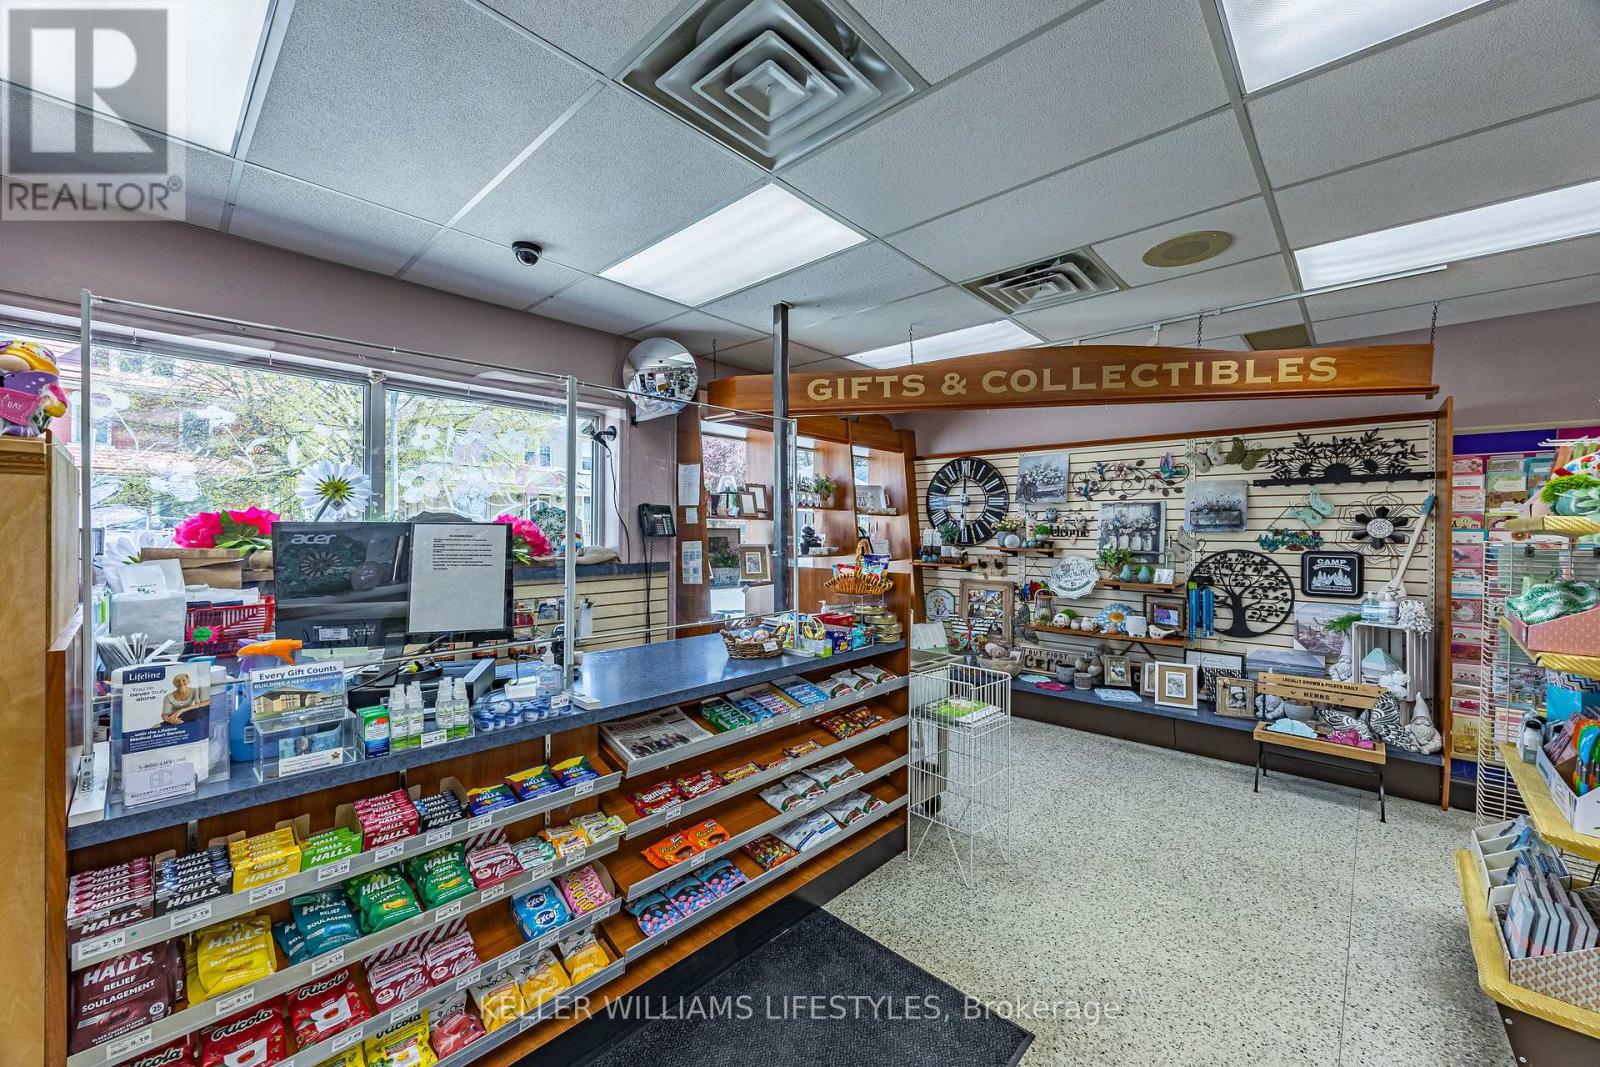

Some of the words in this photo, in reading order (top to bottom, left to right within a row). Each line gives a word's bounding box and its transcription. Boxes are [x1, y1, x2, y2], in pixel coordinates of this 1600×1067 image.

[806, 374, 926, 401] GIFTS
[941, 372, 967, 396] &
[982, 356, 1338, 394] COLLECTIBLES
[290, 534, 337, 545] acer
[1050, 525, 1090, 538] elcome
[1316, 558, 1347, 566] CAMP
[1028, 649, 1043, 657] BUT
[1046, 651, 1068, 661] FIRST
[129, 671, 161, 681] Lifeline
[259, 672, 286, 682] Every
[287, 668, 305, 677] Gift
[307, 664, 337, 674] Counts
[254, 681, 286, 689] BUILDING
[1302, 679, 1321, 687] GROWN
[1304, 691, 1331, 700] HERBS
[642, 786, 672, 803] Skittles
[428, 811, 462, 828] HALLS
[371, 827, 411, 846] HALLS
[311, 845, 353, 865] HALLS
[424, 852, 460, 873] HALLS
[243, 864, 290, 885] HALLS
[362, 874, 403, 896] HALLS
[167, 886, 221, 910] HALLS
[526, 893, 547, 908] excel
[302, 900, 347, 916] HALLS
[535, 909, 557, 925] excel
[81, 908, 143, 935] HALLS
[306, 913, 352, 931] SOULAGEMEN
[208, 927, 265, 950] HALLS
[83, 951, 155, 987] HALLS
[103, 974, 137, 992] RELIEF
[298, 970, 350, 1000] Ricola
[81, 978, 157, 1013] SOULAGEMENT
[379, 989, 392, 999] 44
[211, 1009, 273, 1041] Ricola
